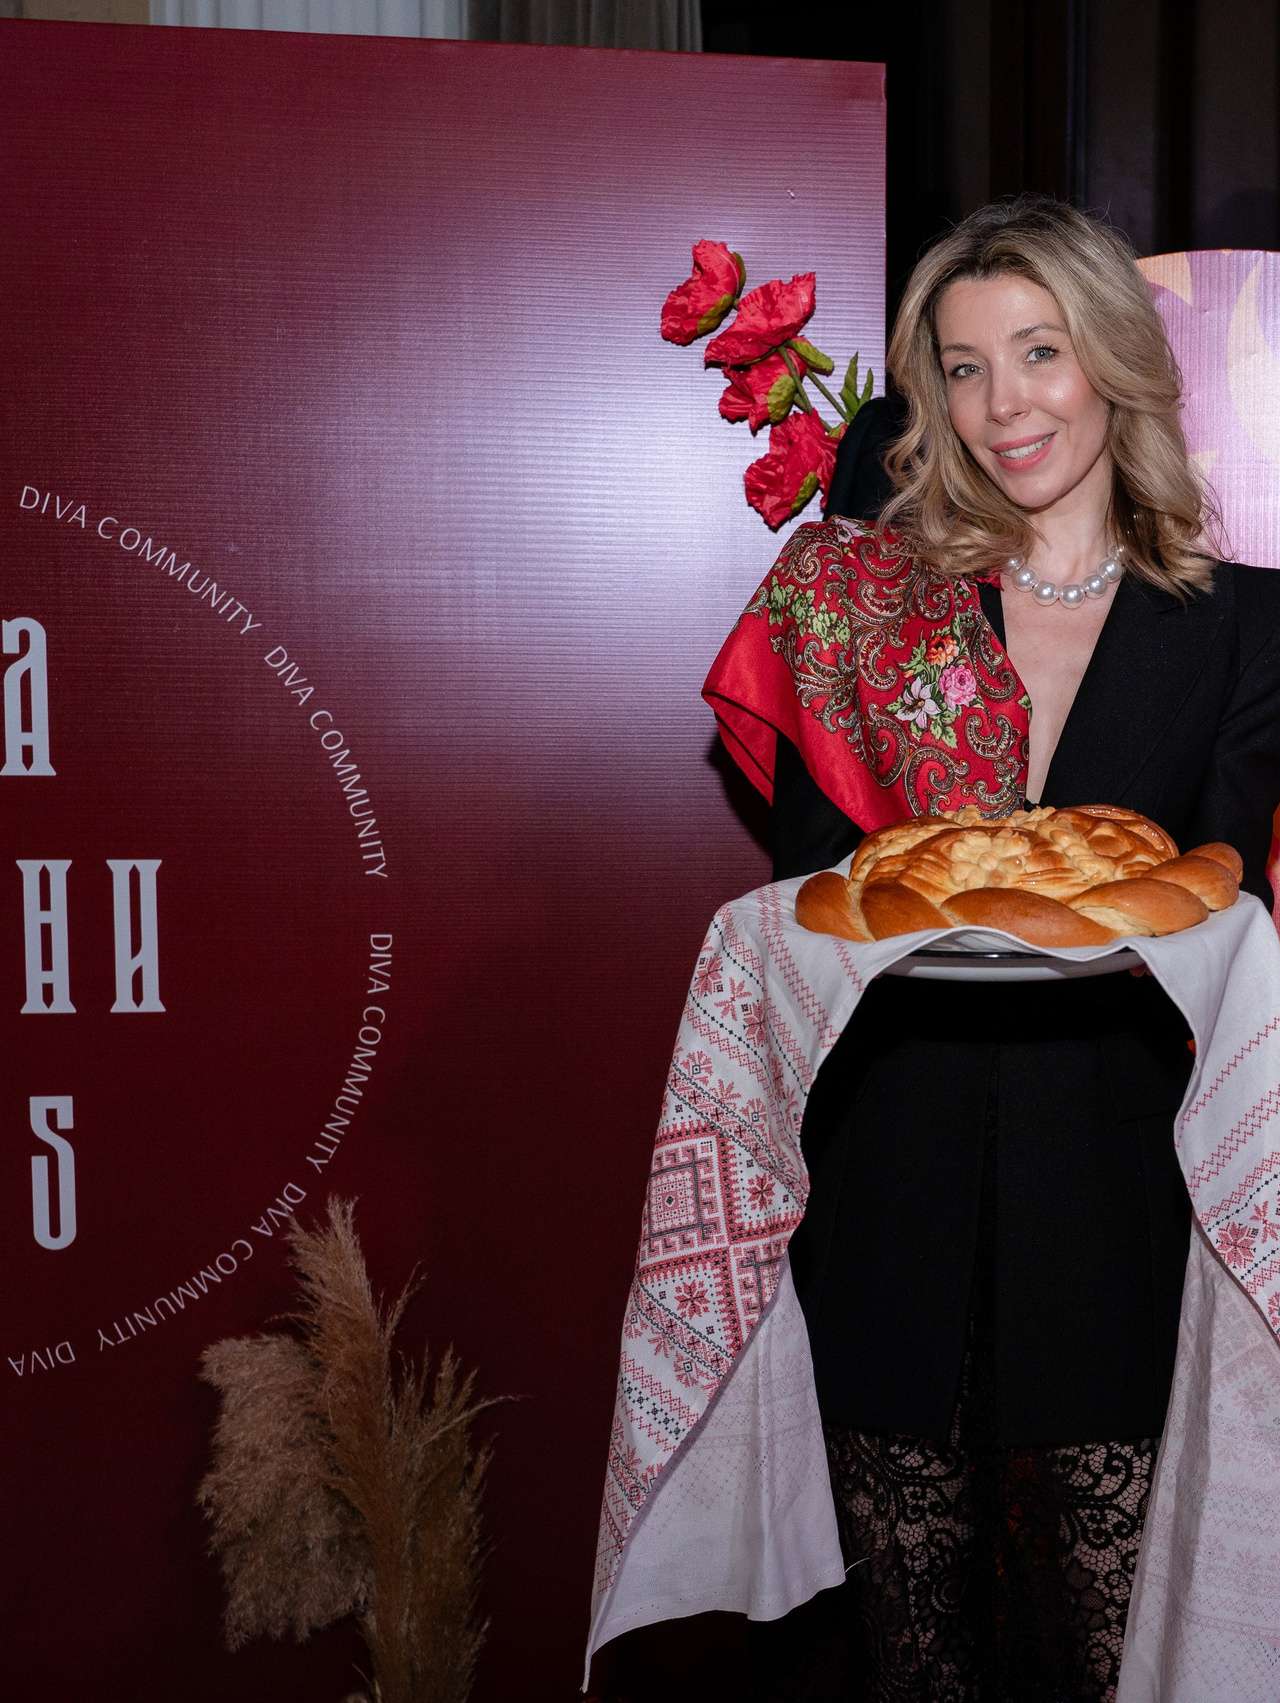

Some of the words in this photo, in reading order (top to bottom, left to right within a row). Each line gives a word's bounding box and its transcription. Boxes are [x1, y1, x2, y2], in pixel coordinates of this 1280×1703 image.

[19, 485, 87, 529] DIVA
[97, 516, 263, 635] COMMUNITY
[263, 645, 315, 707] DIVA
[309, 709, 389, 879] COMMUNITY
[366, 933, 393, 995] DIVA
[305, 1005, 386, 1174] COMMUNITY
[250, 1181, 308, 1237] DIVA
[97, 1239, 254, 1352] COMMUNITY
[7, 1340, 77, 1377] DIVA
